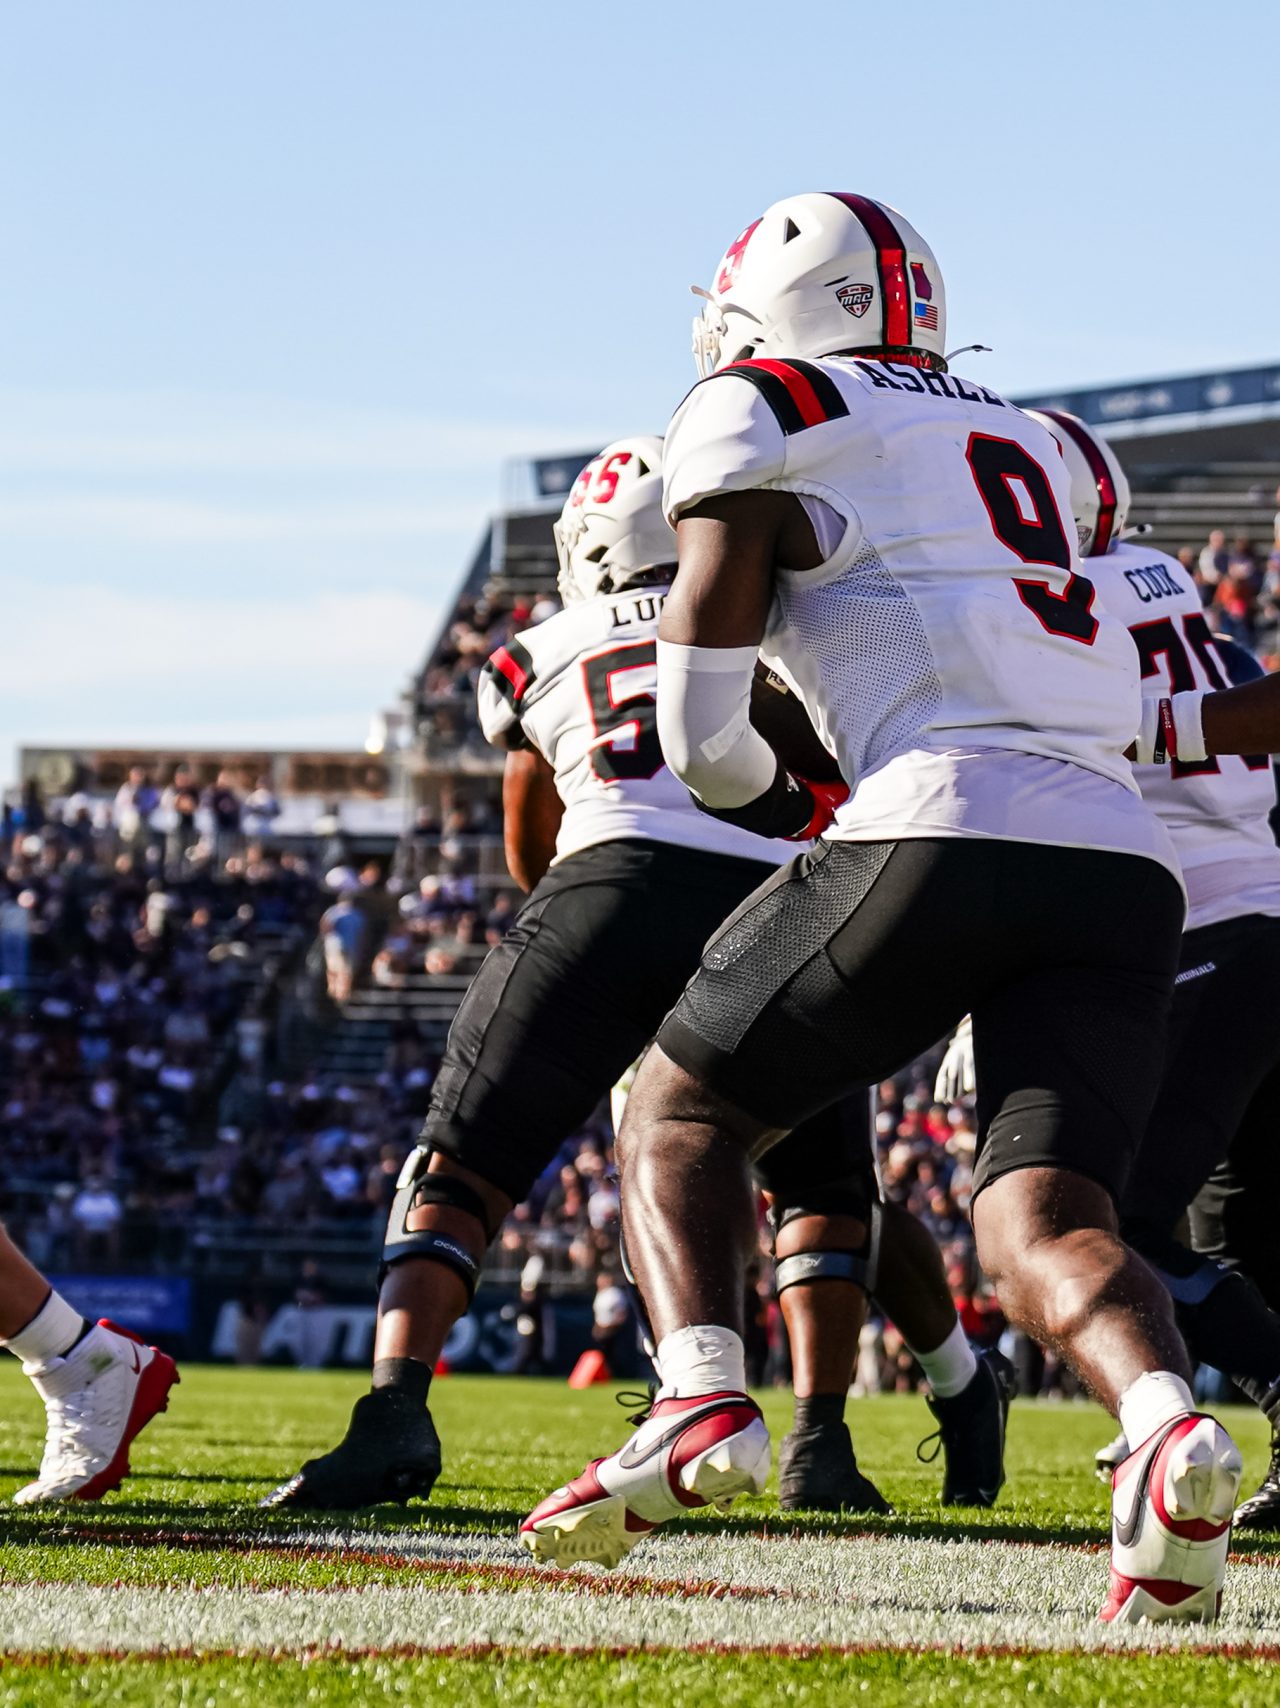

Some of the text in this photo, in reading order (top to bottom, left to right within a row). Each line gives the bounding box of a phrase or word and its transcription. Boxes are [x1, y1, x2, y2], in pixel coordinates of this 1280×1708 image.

[841, 292, 872, 306] MAC
[965, 431, 1100, 646] 9
[1122, 563, 1185, 603] COOK
[609, 596, 665, 628] LU
